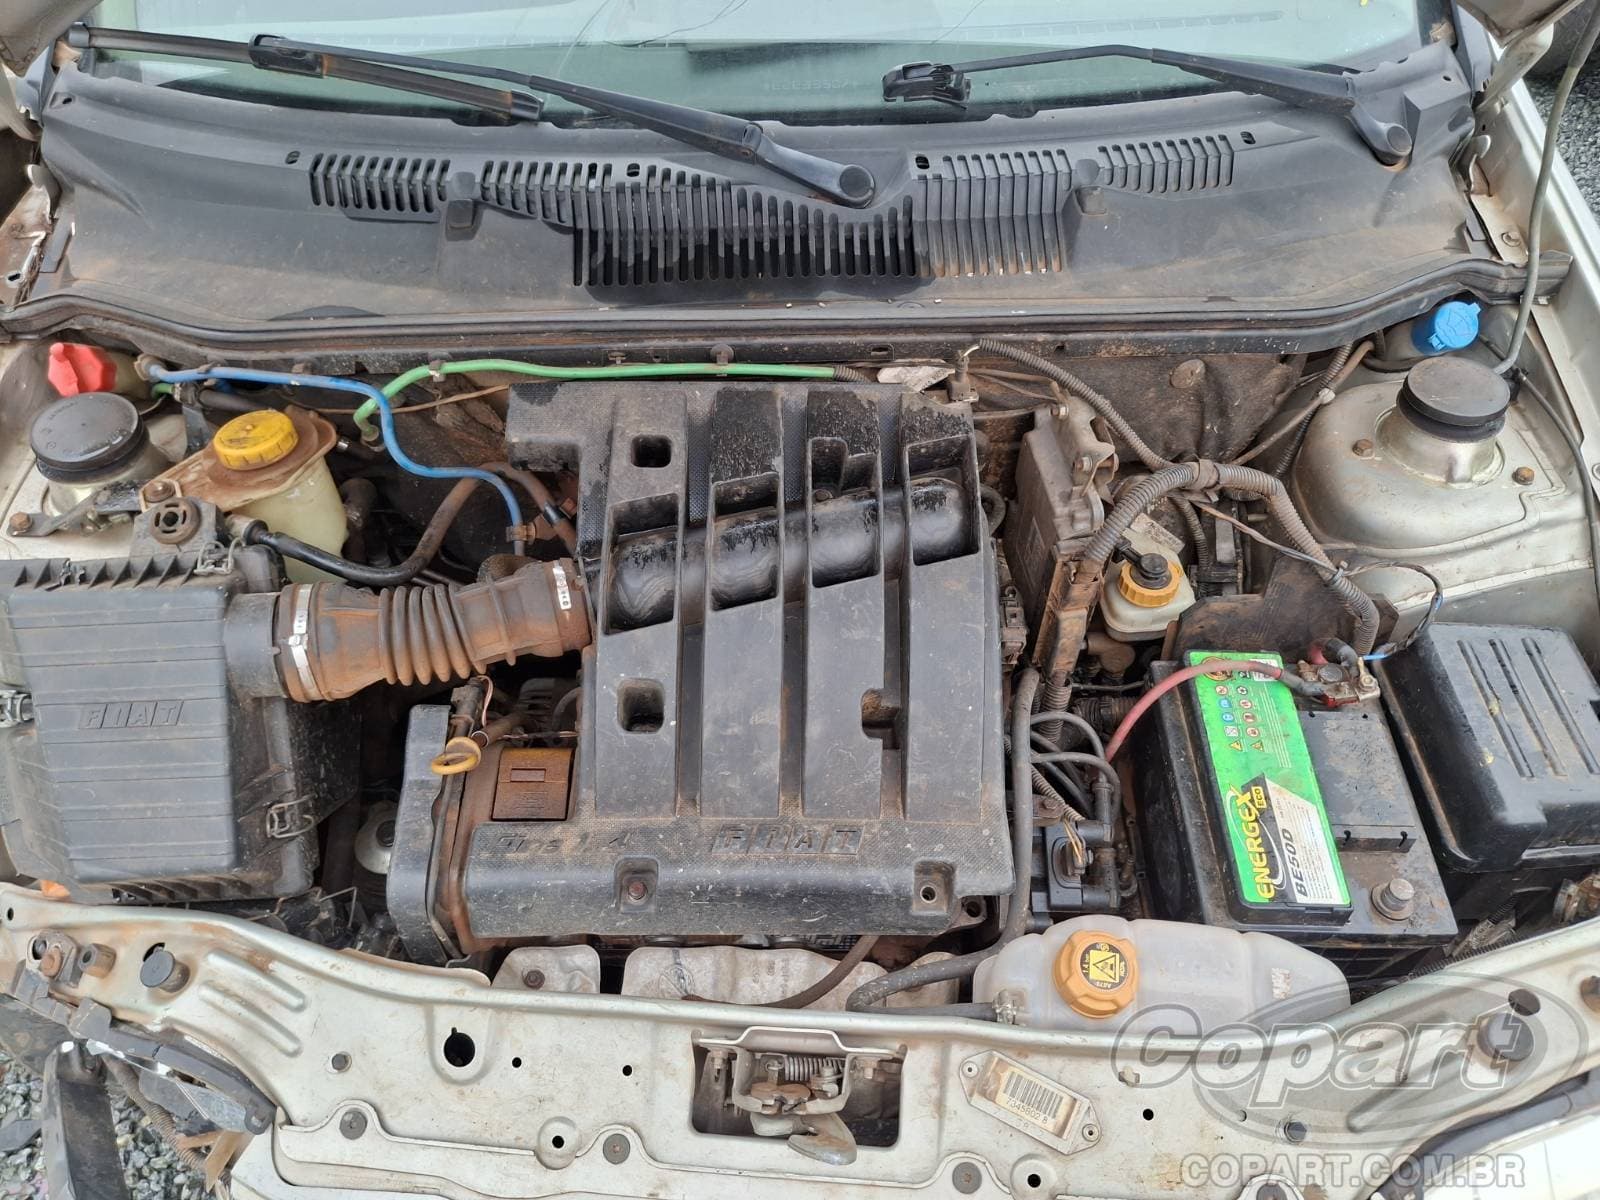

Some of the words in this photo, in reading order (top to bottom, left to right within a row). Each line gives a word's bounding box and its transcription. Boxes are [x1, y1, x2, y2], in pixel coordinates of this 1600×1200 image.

[84, 703, 180, 728] FIAT
[1254, 787, 1265, 807] ECO
[719, 826, 860, 851] FIAT
[1229, 783, 1275, 899] ENERGEX
[1282, 828, 1308, 897] BE50D
